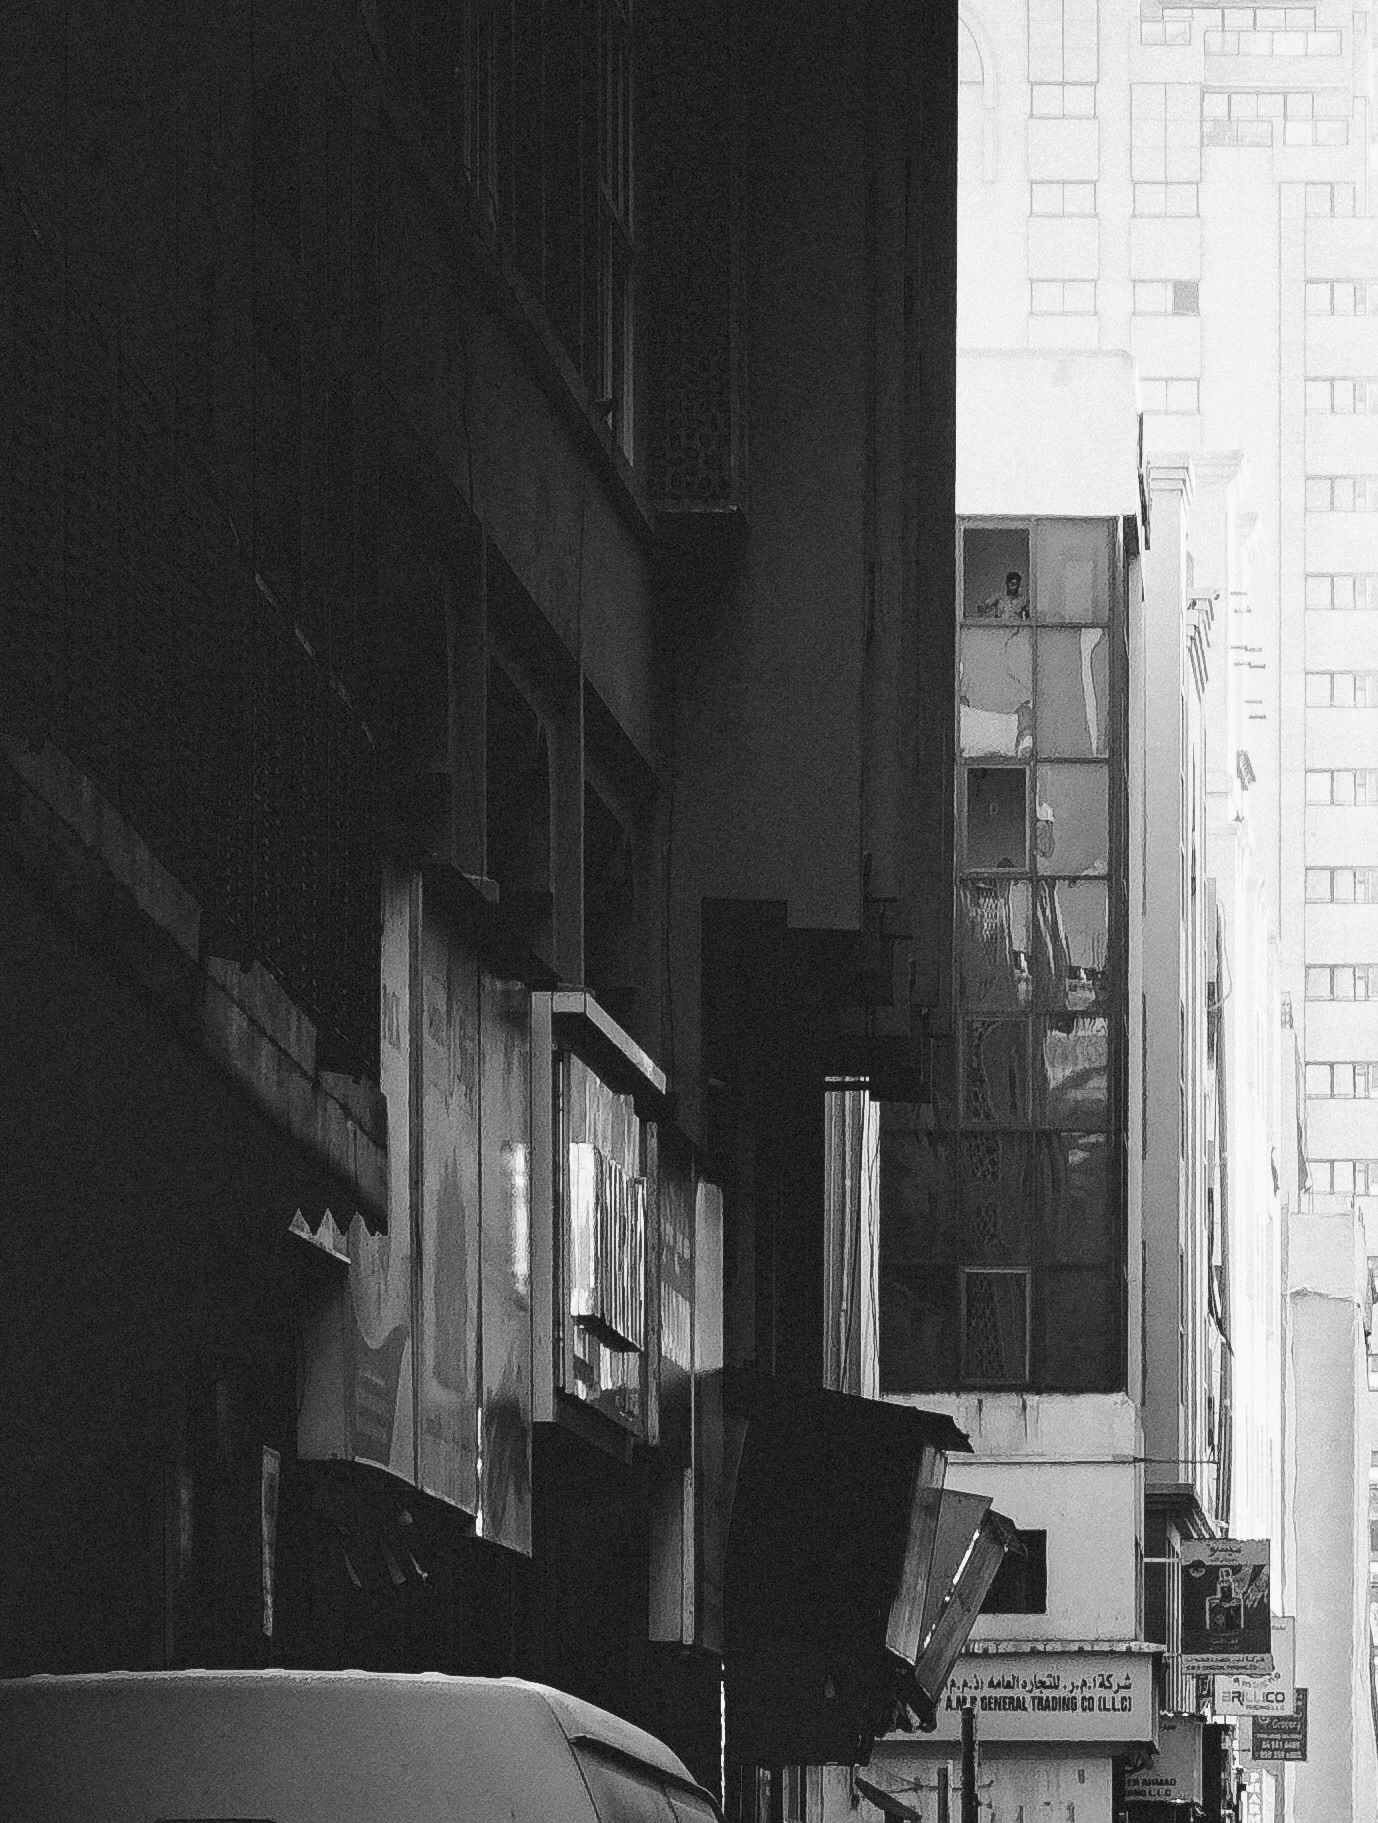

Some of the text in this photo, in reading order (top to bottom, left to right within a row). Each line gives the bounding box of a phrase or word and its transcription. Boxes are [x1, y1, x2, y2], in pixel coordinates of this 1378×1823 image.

[1098, 1672, 1133, 1694] شركة
[980, 1695, 1028, 1712] GENERAL
[1030, 1695, 1078, 1712] TRADING
[1080, 1695, 1095, 1712] CO
[1222, 1691, 1285, 1705] BRILLICO
